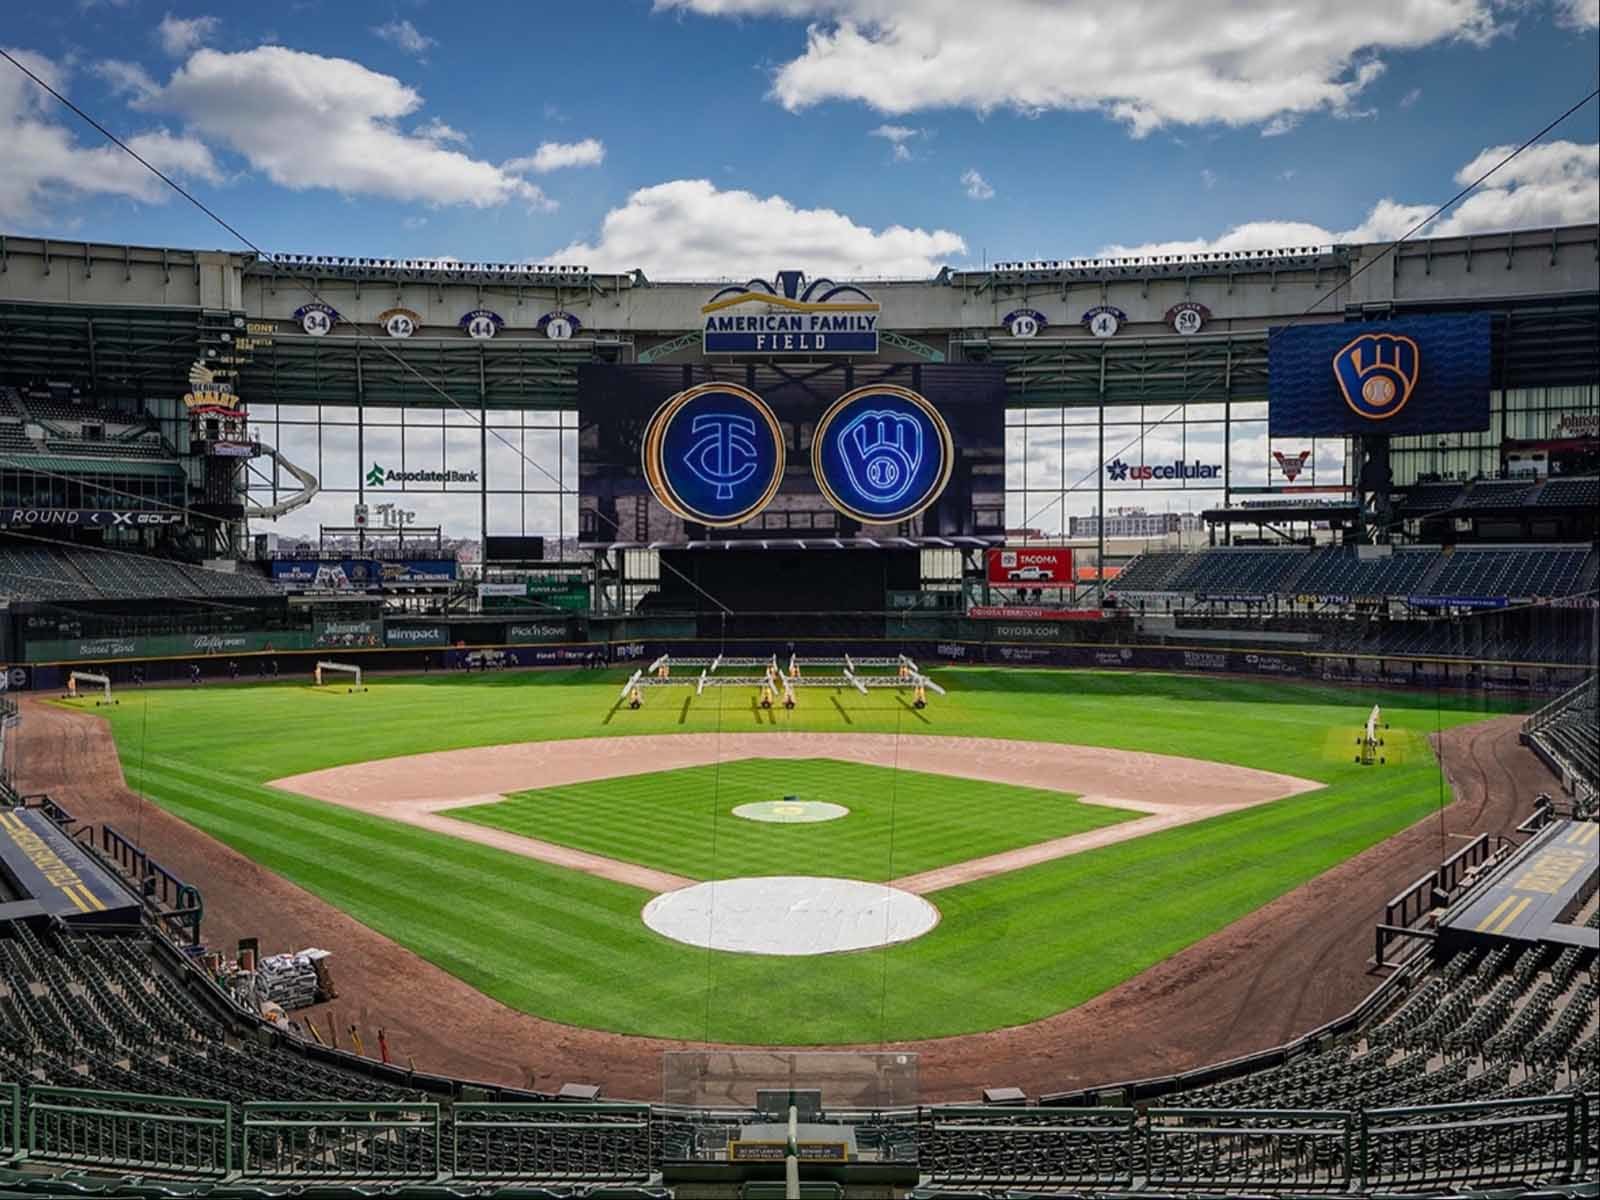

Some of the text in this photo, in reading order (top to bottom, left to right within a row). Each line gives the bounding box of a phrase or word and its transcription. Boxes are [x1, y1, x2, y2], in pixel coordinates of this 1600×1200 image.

[307, 315, 327, 331] 34
[391, 319, 410, 333] 42
[705, 315, 876, 331] AMERICAN FAMILY
[1100, 319, 1109, 333] 4
[1180, 314, 1196, 324] 50
[472, 321, 491, 335] 44
[556, 324, 563, 337] 1
[1016, 320, 1034, 335] 19
[757, 334, 826, 350] FIELD
[1130, 460, 1222, 480] uscellular
[12, 510, 80, 524] ROUND
[1019, 555, 1057, 564] TACOMA
